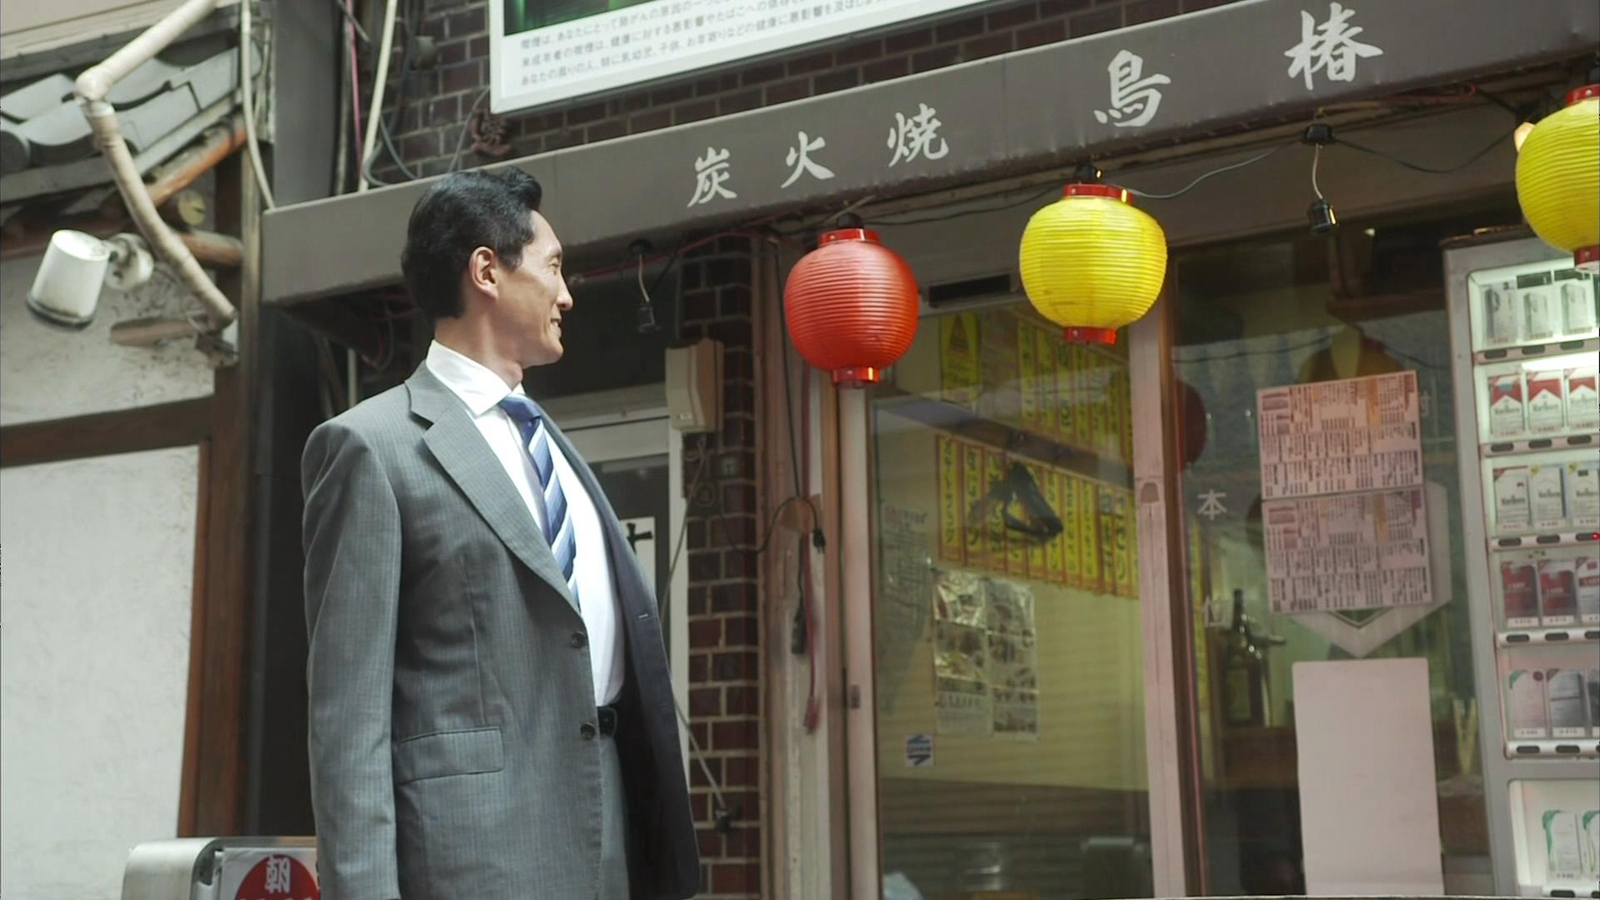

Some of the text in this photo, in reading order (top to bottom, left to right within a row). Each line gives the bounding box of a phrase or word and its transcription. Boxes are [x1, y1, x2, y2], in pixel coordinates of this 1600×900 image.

[687, 2, 1384, 208] 炭火焼 鳥椿
[1197, 488, 1228, 520] 本
[264, 854, 291, 894] 朝
